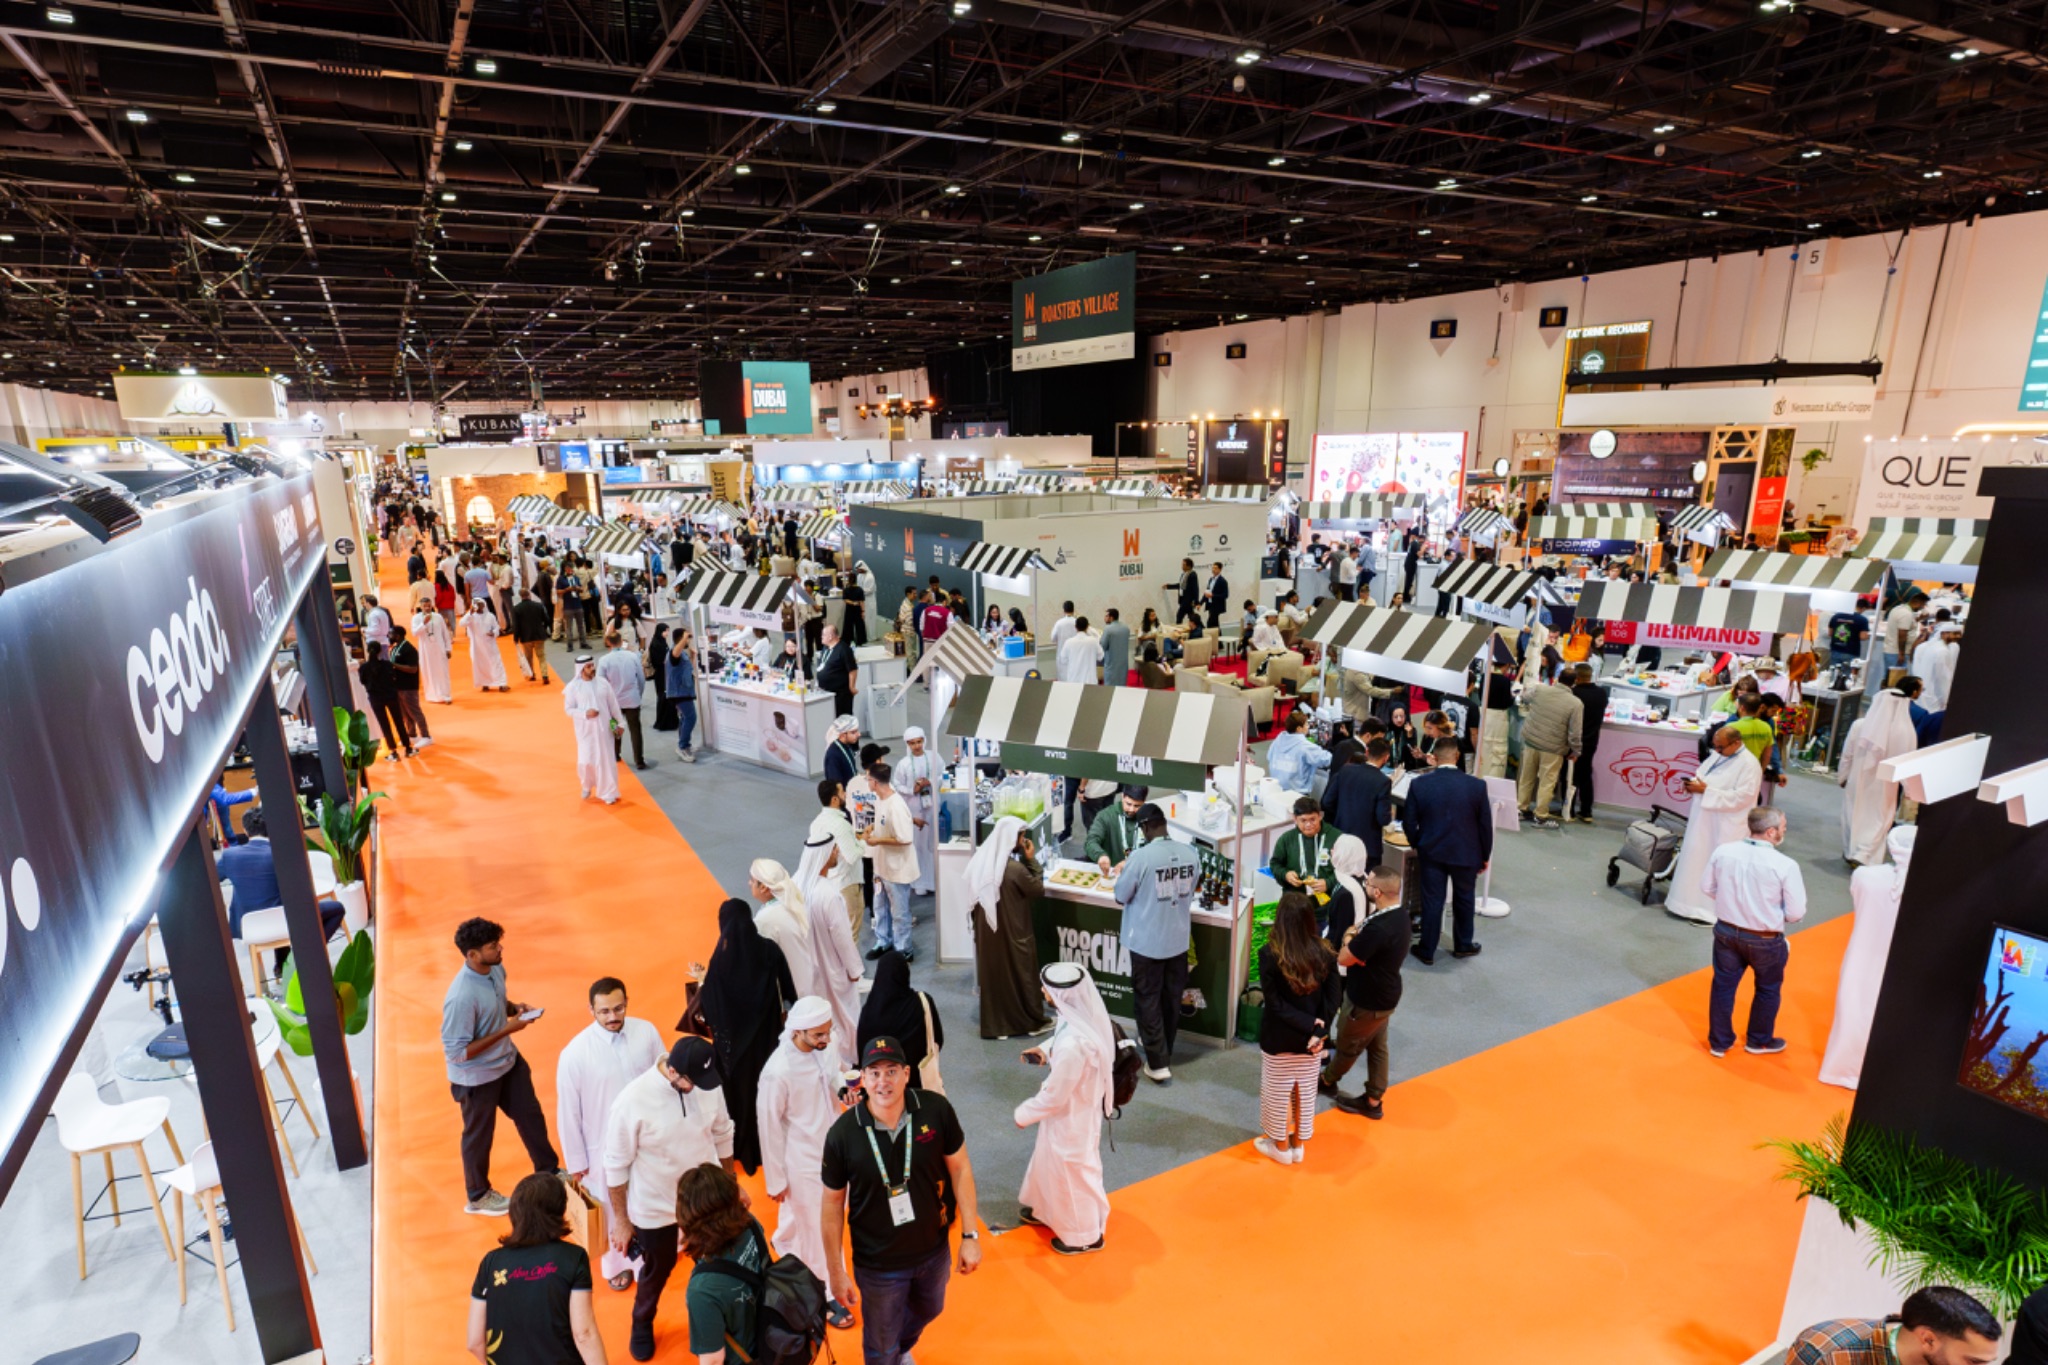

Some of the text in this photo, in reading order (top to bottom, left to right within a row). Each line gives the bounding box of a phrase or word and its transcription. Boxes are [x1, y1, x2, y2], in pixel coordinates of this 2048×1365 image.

[1810, 250, 1820, 264] 5
[1503, 292, 1510, 304] 6
[1041, 291, 1119, 323] ROASTERS VILLAGE
[1566, 322, 1649, 338] EAT DRINK RECHARGE
[753, 389, 787, 407] DUBAI
[1791, 401, 1871, 413] Neumann Kaffee Gruppe
[468, 418, 521, 430] KUBAN
[1882, 455, 1971, 488] QUE
[1898, 493, 1932, 501] TRADING
[1934, 493, 1963, 501] GROUP
[1555, 540, 1601, 548] DOPPIO
[1119, 563, 1143, 577] DUBAI
[1610, 629, 1628, 639] 108
[1155, 864, 1194, 882] TAPER
[1057, 926, 1091, 951] YOO
